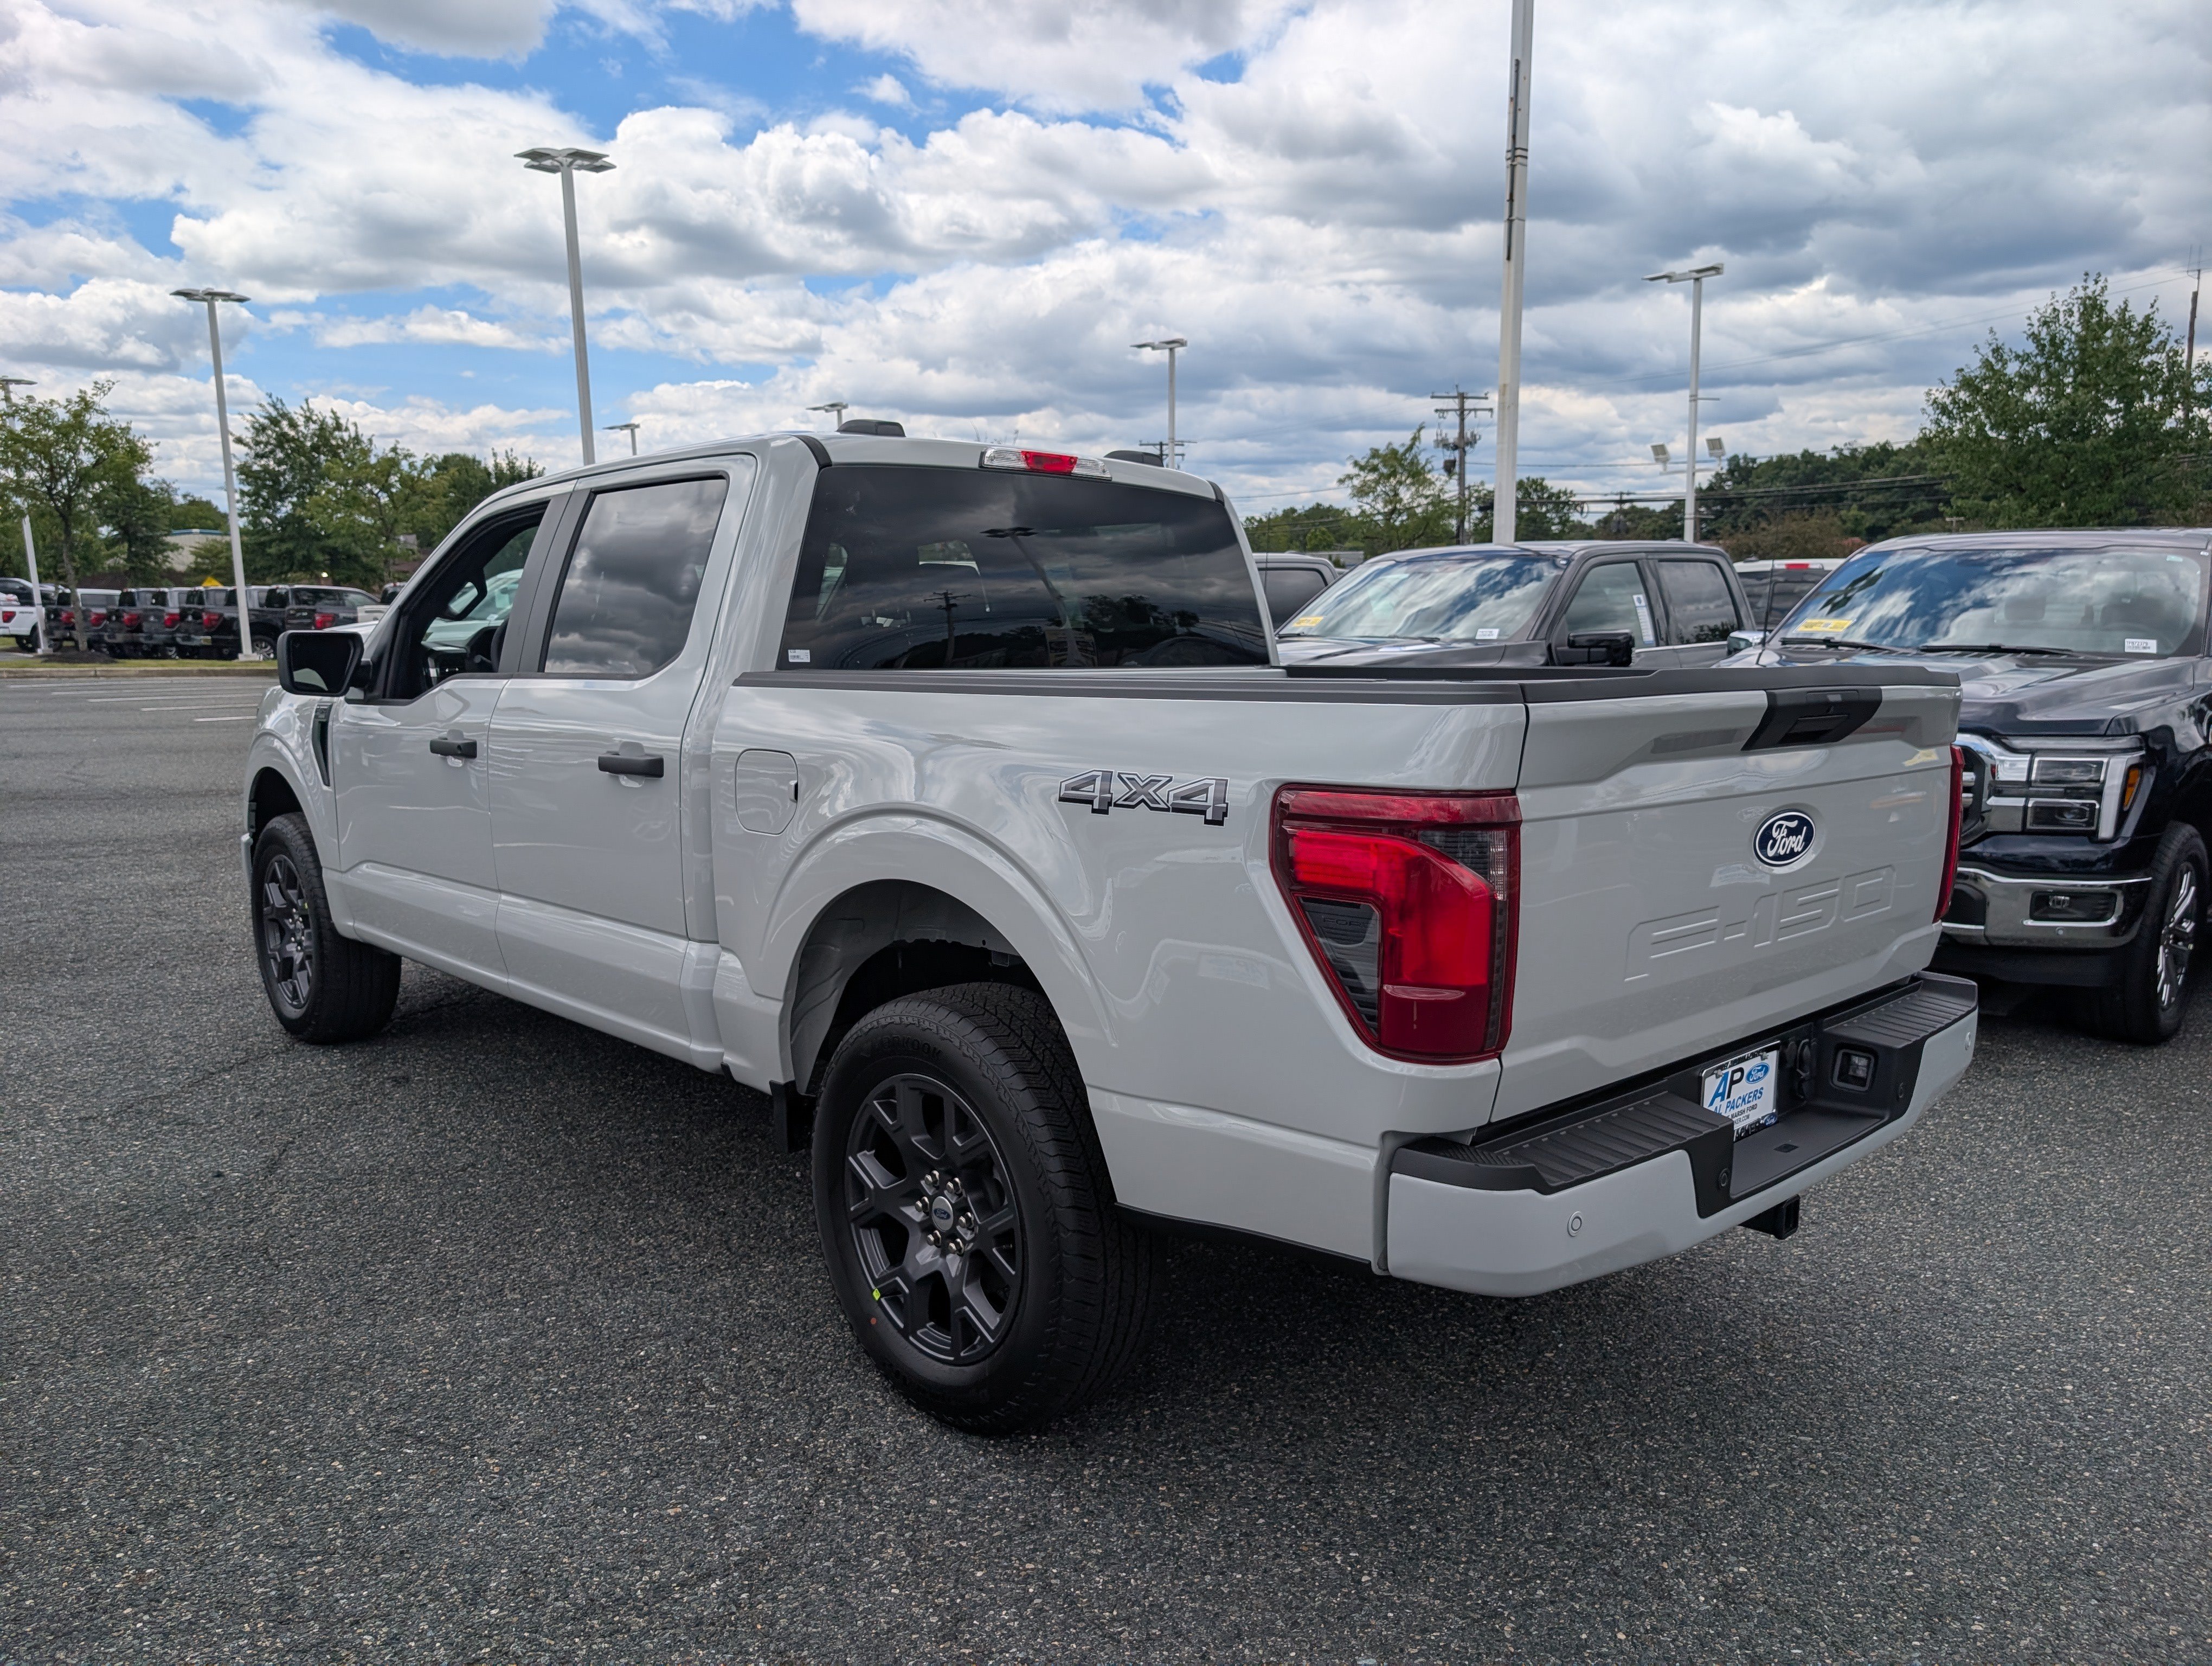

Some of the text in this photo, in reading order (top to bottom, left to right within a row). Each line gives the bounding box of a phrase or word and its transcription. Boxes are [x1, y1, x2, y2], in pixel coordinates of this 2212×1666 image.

[1058, 768, 1230, 828] 4X4
[1767, 819, 1807, 857] Ford
[1624, 865, 1895, 982] F-150
[1725, 1086, 1764, 1113] PACKERS
[1746, 1103, 1758, 1113] FORD
